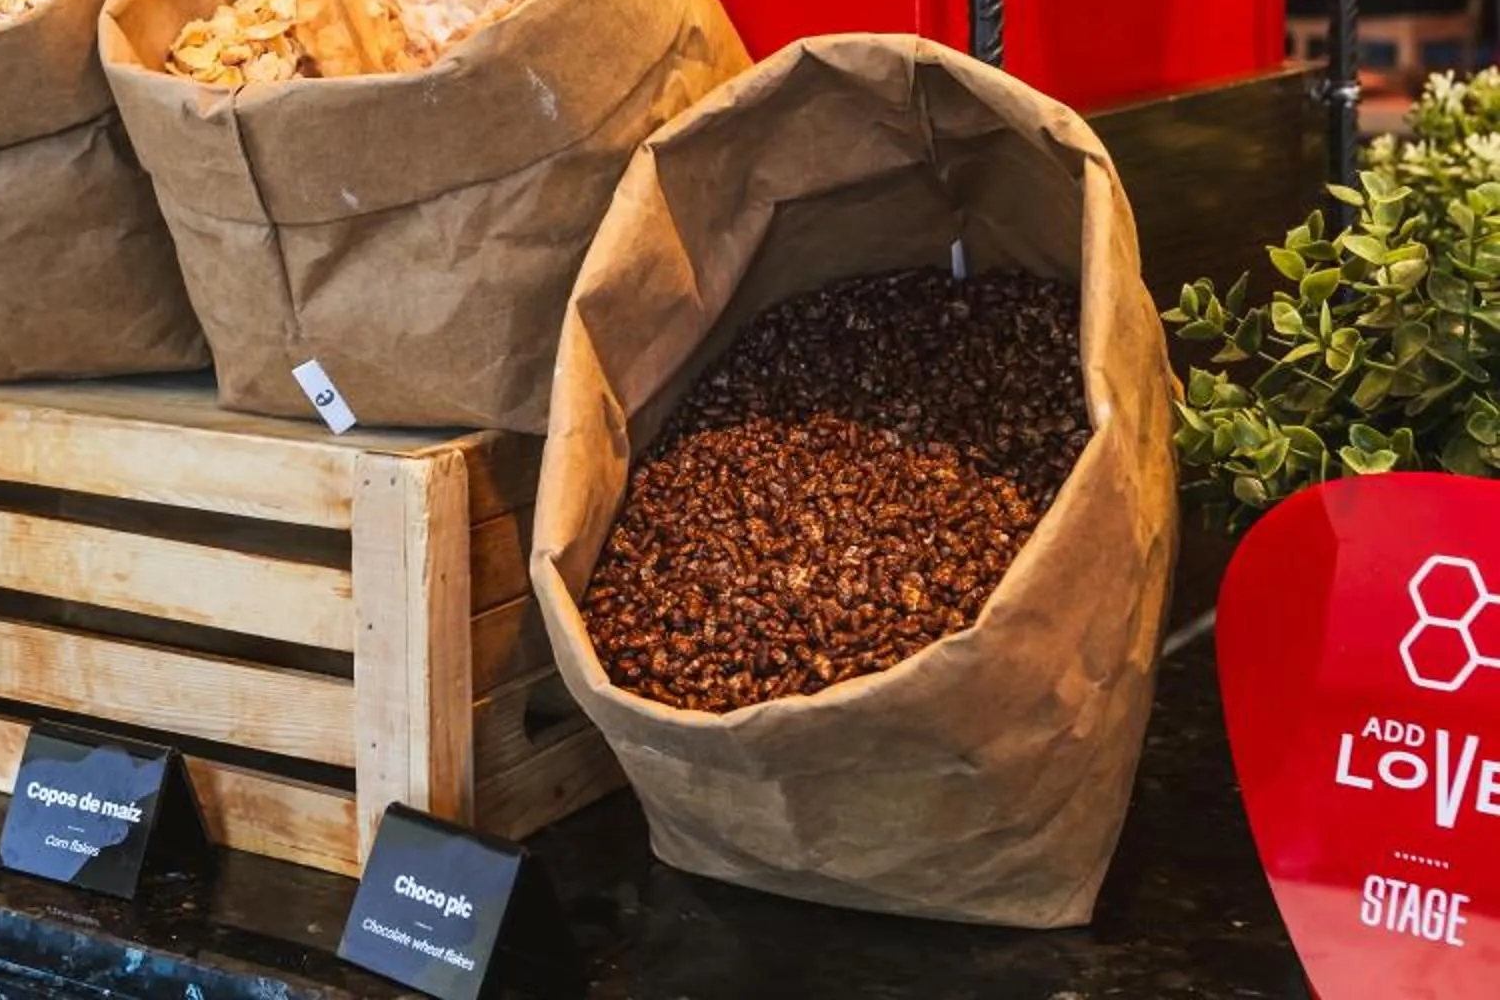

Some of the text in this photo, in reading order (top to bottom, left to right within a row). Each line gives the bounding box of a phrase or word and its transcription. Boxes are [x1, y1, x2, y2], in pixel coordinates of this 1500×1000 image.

[1361, 715, 1426, 748] ADD
[26, 781, 78, 807] Copos
[79, 791, 101, 813] de
[393, 874, 473, 919] Choco pic
[1359, 873, 1471, 947] STAGE
[361, 917, 476, 972] Chocolate wheat flakes
